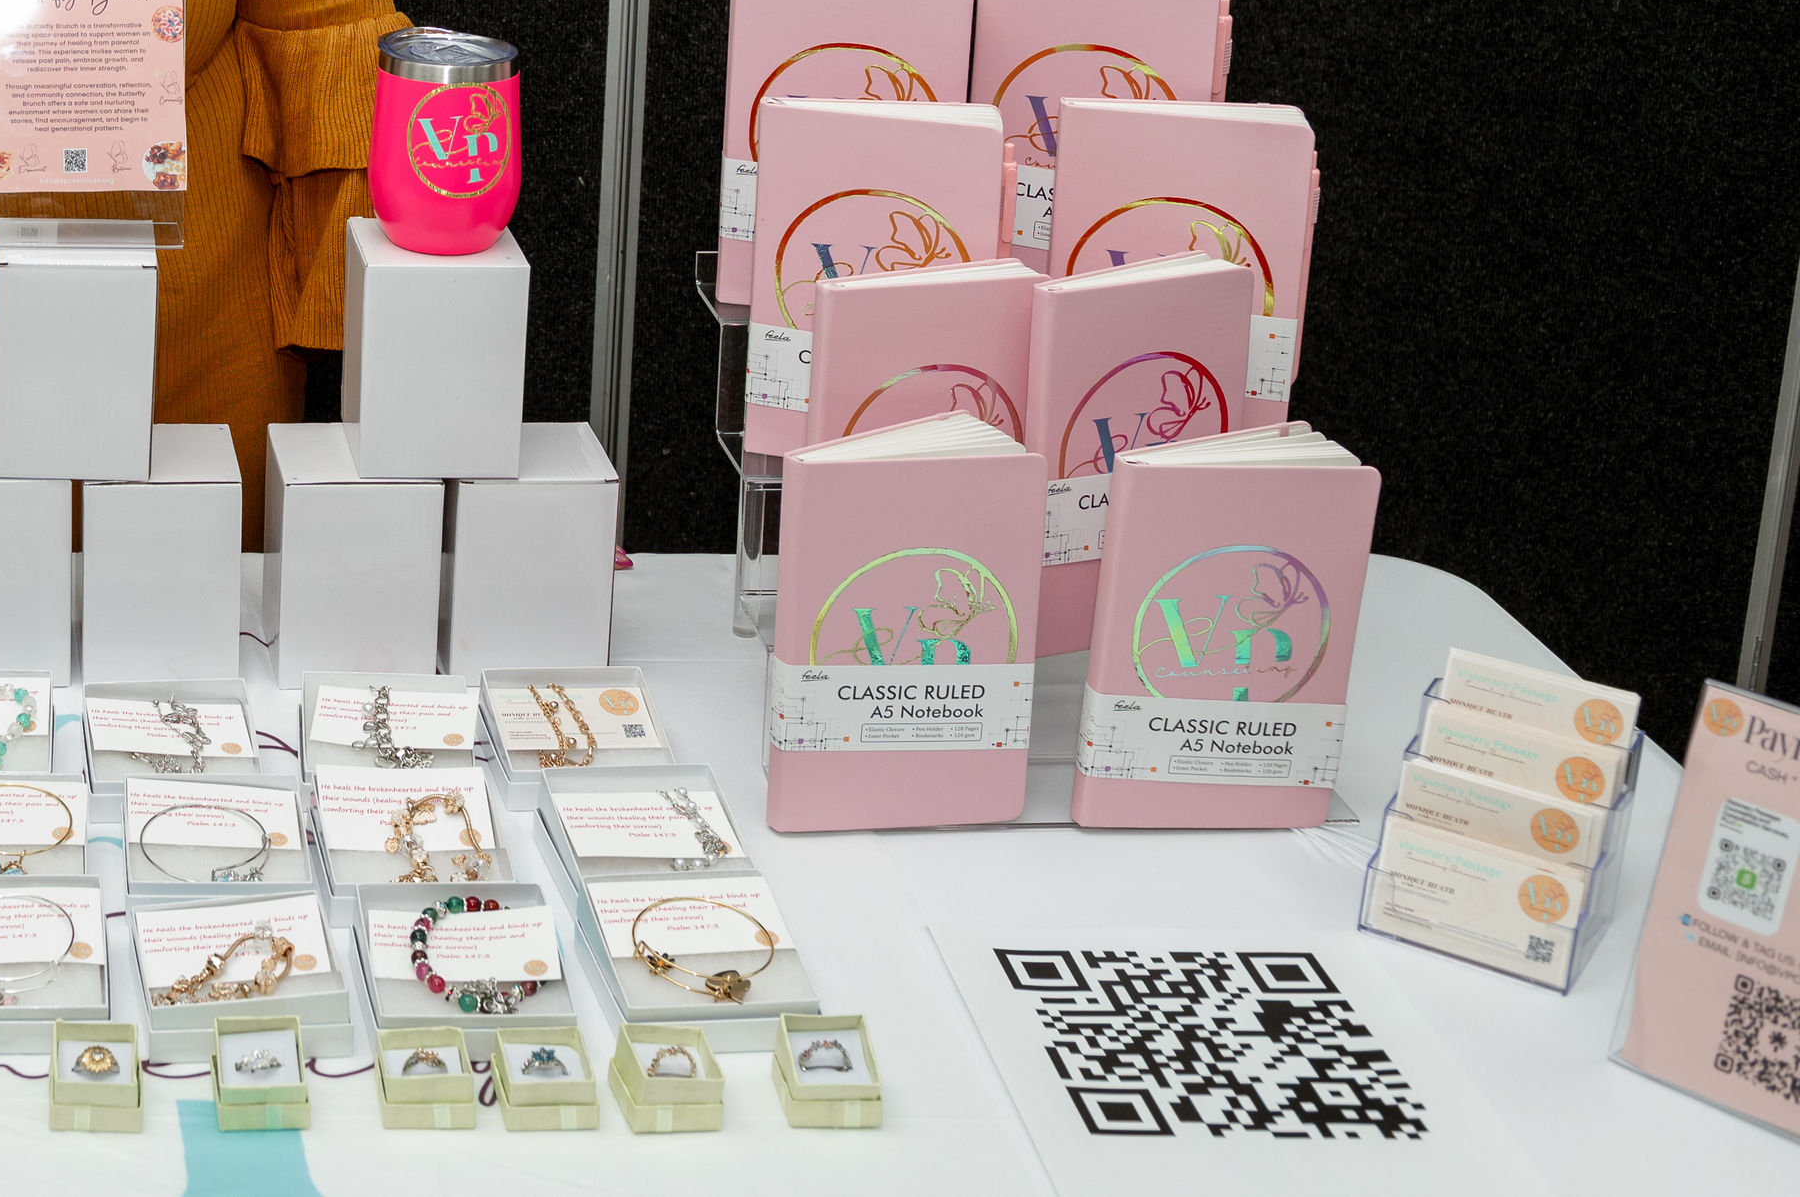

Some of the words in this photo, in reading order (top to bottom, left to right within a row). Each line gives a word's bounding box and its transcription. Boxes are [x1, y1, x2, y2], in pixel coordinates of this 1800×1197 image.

[51, 125, 92, 133] generational
[764, 330, 791, 341] feela
[1048, 483, 1071, 494] feela
[801, 671, 830, 682] feela
[1457, 668, 1509, 689] Visionary
[1513, 682, 1558, 702] Passage
[837, 685, 917, 700] CLASSIC
[925, 685, 985, 700] RULED
[870, 705, 894, 718] A5
[901, 704, 984, 718] Notebook
[1113, 700, 1143, 711] feela
[1149, 717, 1230, 735] CLASSIC
[1236, 722, 1297, 737] RULED
[1180, 739, 1203, 751] A5
[1210, 740, 1294, 755] Notebook
[1437, 725, 1490, 747] Visionary
[1494, 739, 1539, 760] Passage
[1746, 761, 1787, 784] CASH
[323, 807, 364, 815] comforting
